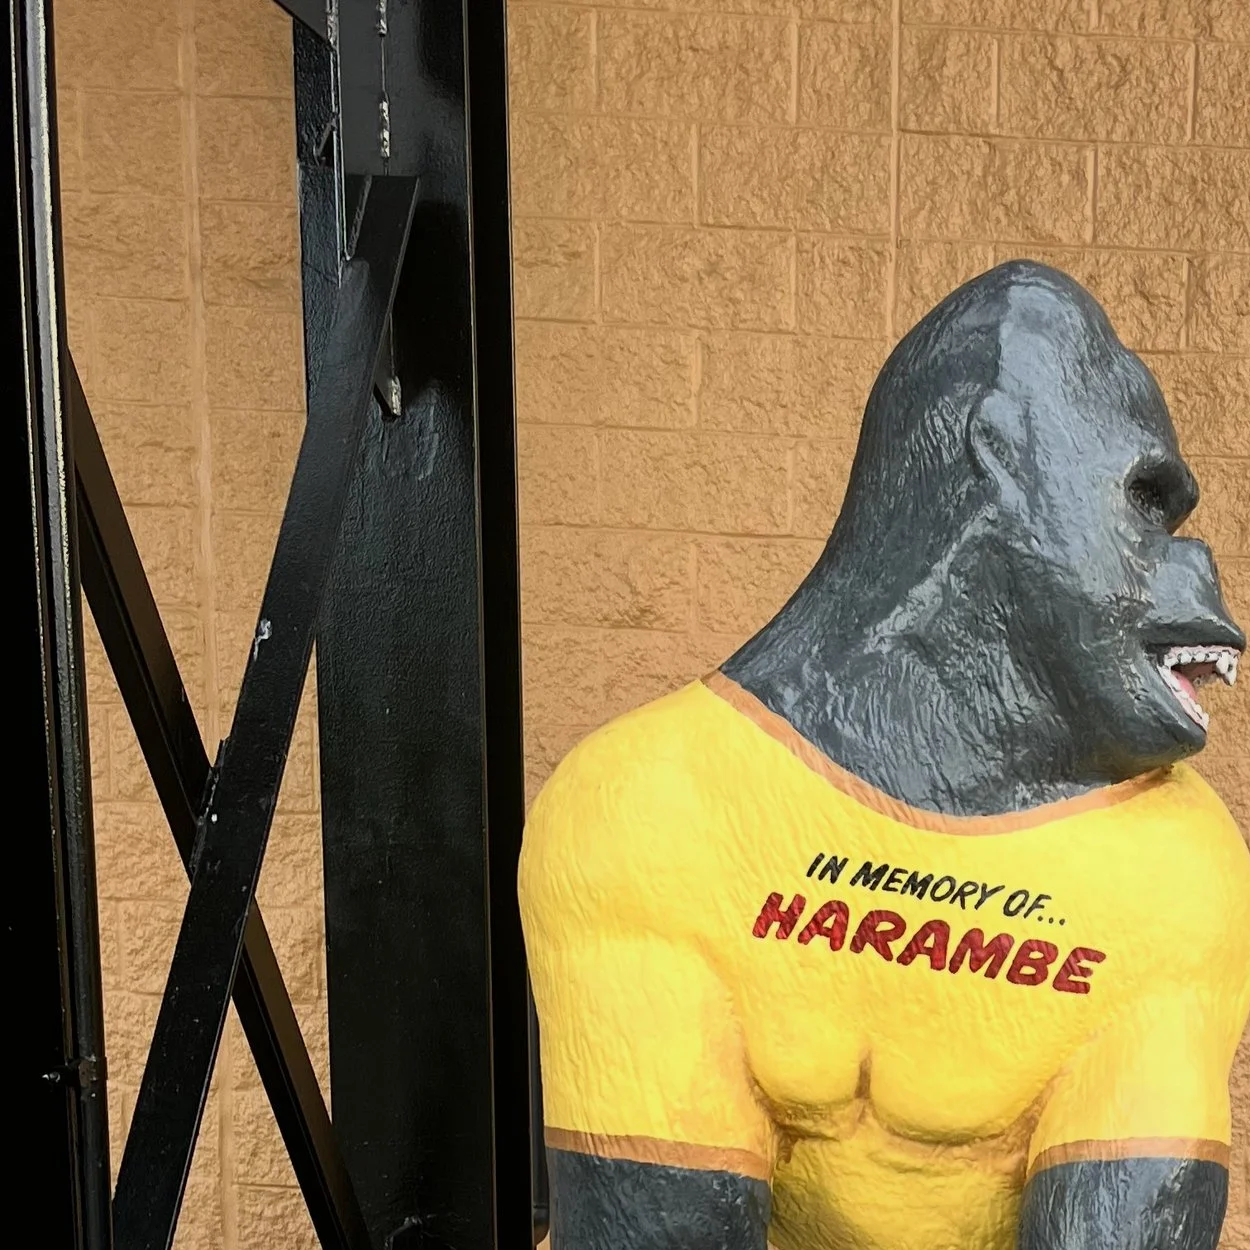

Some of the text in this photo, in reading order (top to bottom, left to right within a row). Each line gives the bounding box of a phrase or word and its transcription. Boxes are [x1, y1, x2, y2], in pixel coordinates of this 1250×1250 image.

[806, 852, 1066, 926] IN MEMORY OF...
[752, 891, 1106, 994] HARAMBE
